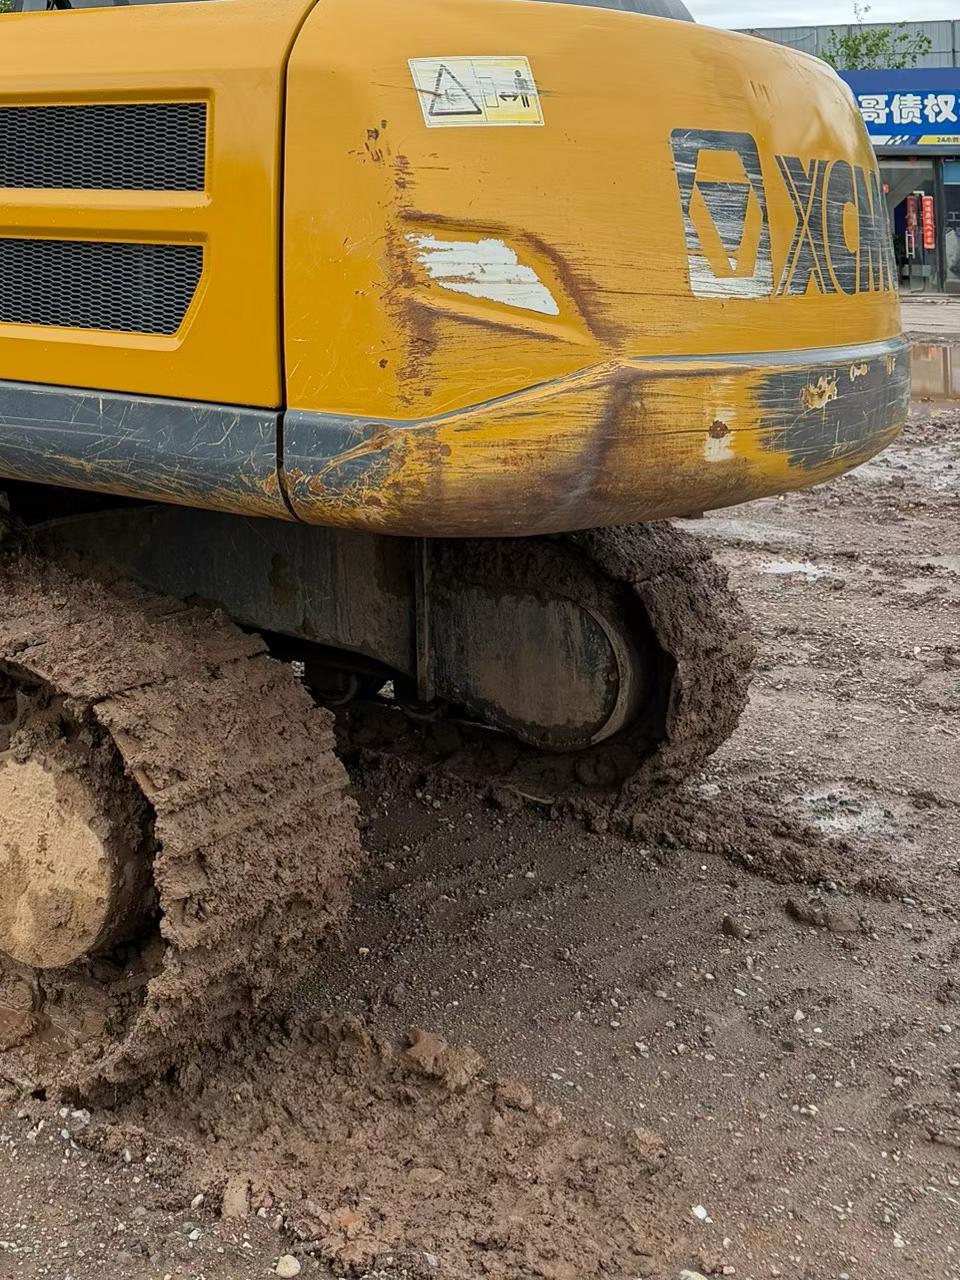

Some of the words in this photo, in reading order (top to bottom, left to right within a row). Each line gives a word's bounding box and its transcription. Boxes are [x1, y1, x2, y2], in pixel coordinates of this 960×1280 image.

[858, 94, 960, 124] 哥债权
[774, 155, 898, 295] XCM
